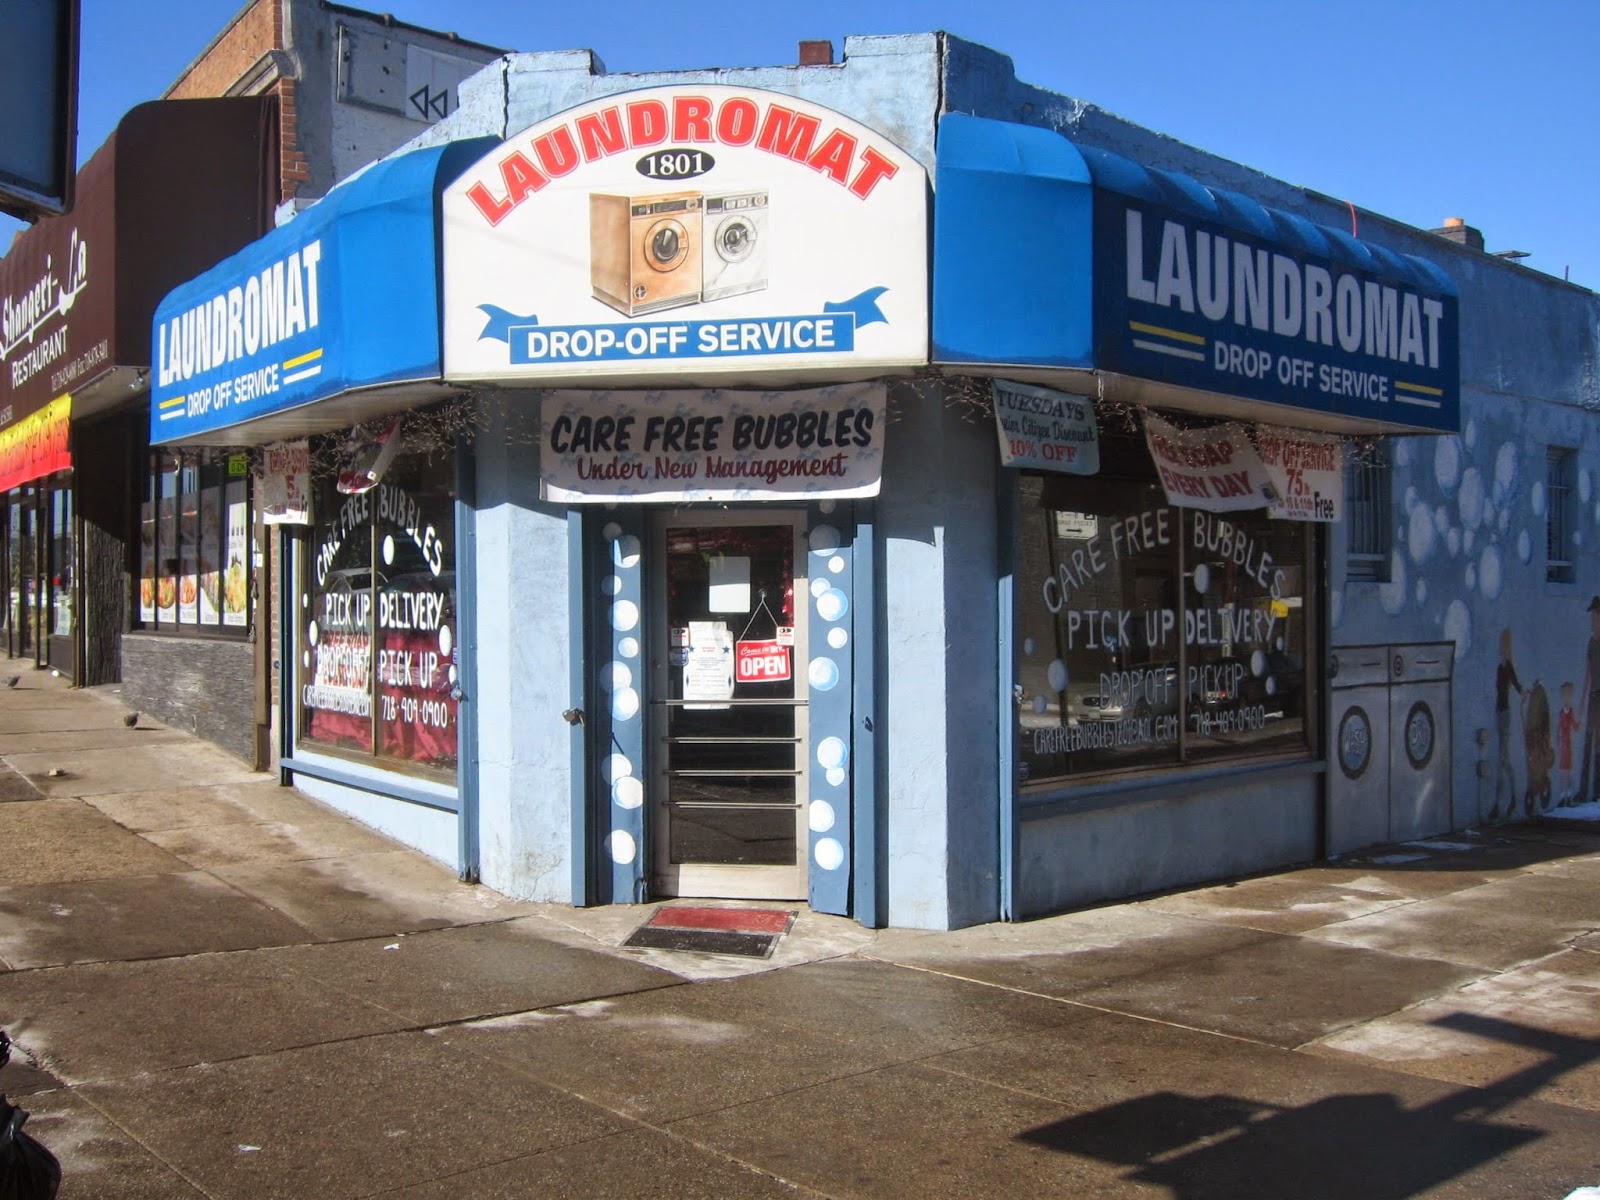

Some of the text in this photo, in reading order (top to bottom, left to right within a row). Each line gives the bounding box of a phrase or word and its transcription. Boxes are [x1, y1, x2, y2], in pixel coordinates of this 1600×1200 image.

[466, 95, 899, 228] LAUNDROMAT
[645, 152, 705, 177] 1801
[1126, 208, 1443, 369] LAUNDROMAT
[159, 239, 321, 387] LAUNDROMAT
[12, 325, 68, 389] RESTAURANT
[527, 319, 836, 359] DROP-OFF SERVICE
[187, 363, 280, 418] DROP OFF SERVICE
[1214, 340, 1389, 402] DROP OFF SERVICE
[996, 389, 1085, 422] TUESDAYS
[551, 408, 874, 453] CARE FREE BUBBLES
[1009, 438, 1078, 462] 10% OFF
[577, 453, 848, 484] Under New Management
[1160, 465, 1253, 498] EVERY DAY
[1314, 491, 1334, 519] Free
[316, 483, 443, 586] CARE FREE BUBBLES
[1043, 508, 1287, 613] CARE FREE BUBBLES
[326, 592, 444, 630] PICK UP DELIVERY
[1068, 608, 1278, 650] PICK UP DELIVERY
[379, 650, 412, 687] PICK
[419, 652, 438, 688] UP
[740, 655, 787, 677] OPEN
[1100, 669, 1144, 710] DROP
[1144, 667, 1175, 705] OFF
